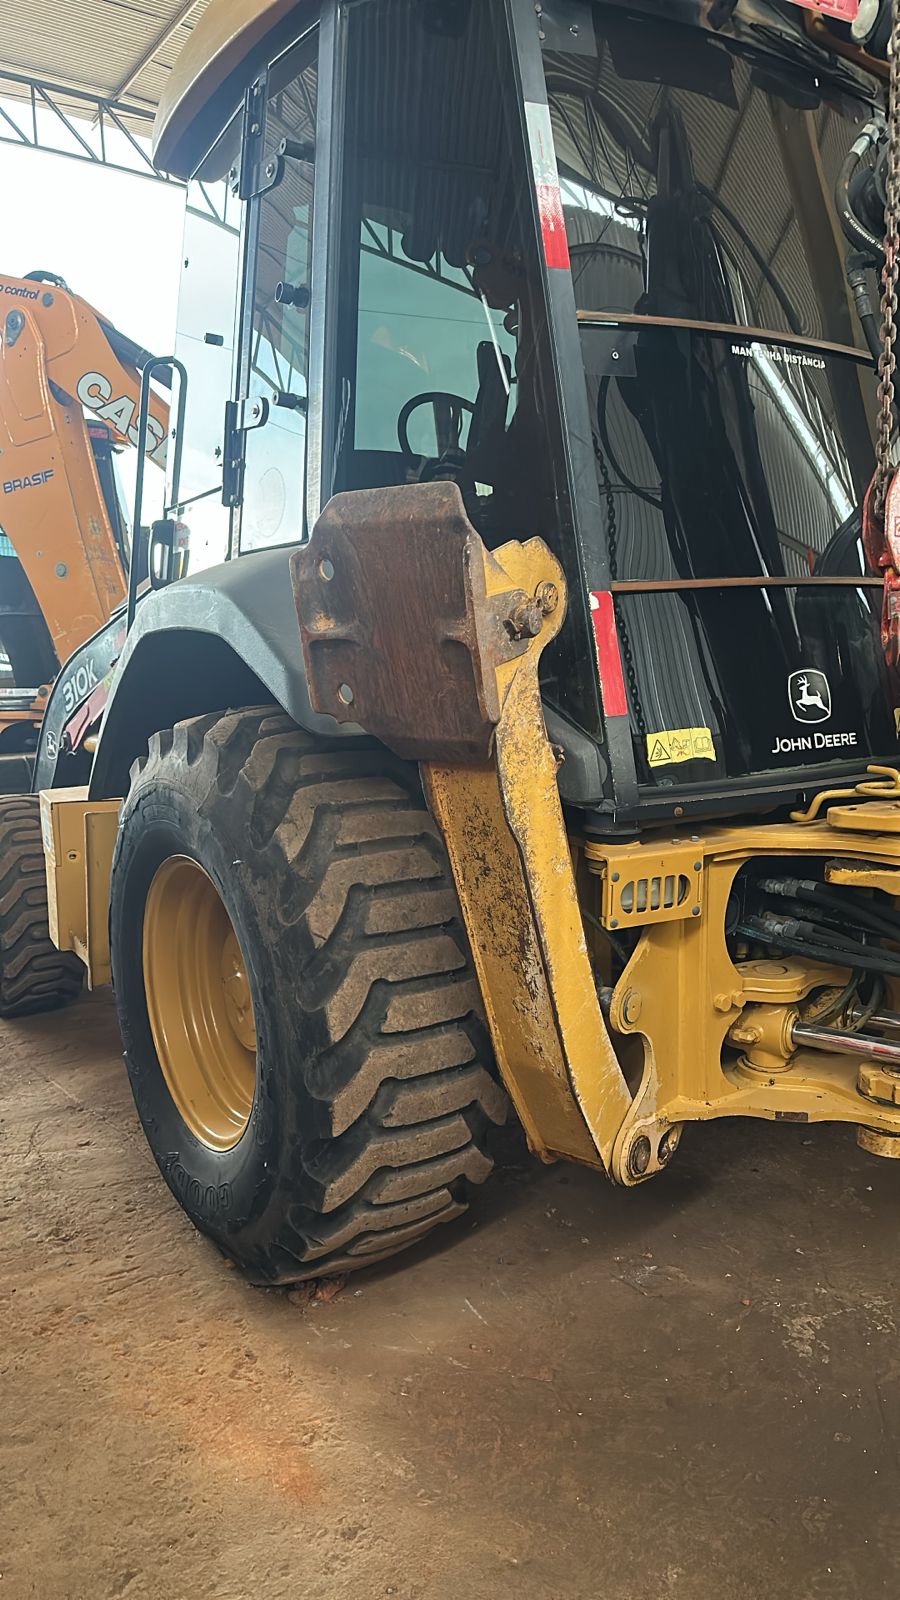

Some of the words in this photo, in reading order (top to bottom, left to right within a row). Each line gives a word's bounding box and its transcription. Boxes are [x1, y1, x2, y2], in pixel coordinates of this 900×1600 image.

[5, 286, 40, 300] control
[76, 371, 169, 472] CAS
[3, 469, 54, 494] BRASIF
[62, 658, 98, 712] 310K
[771, 736, 812, 753] JOHN
[813, 732, 858, 749] DEERE
